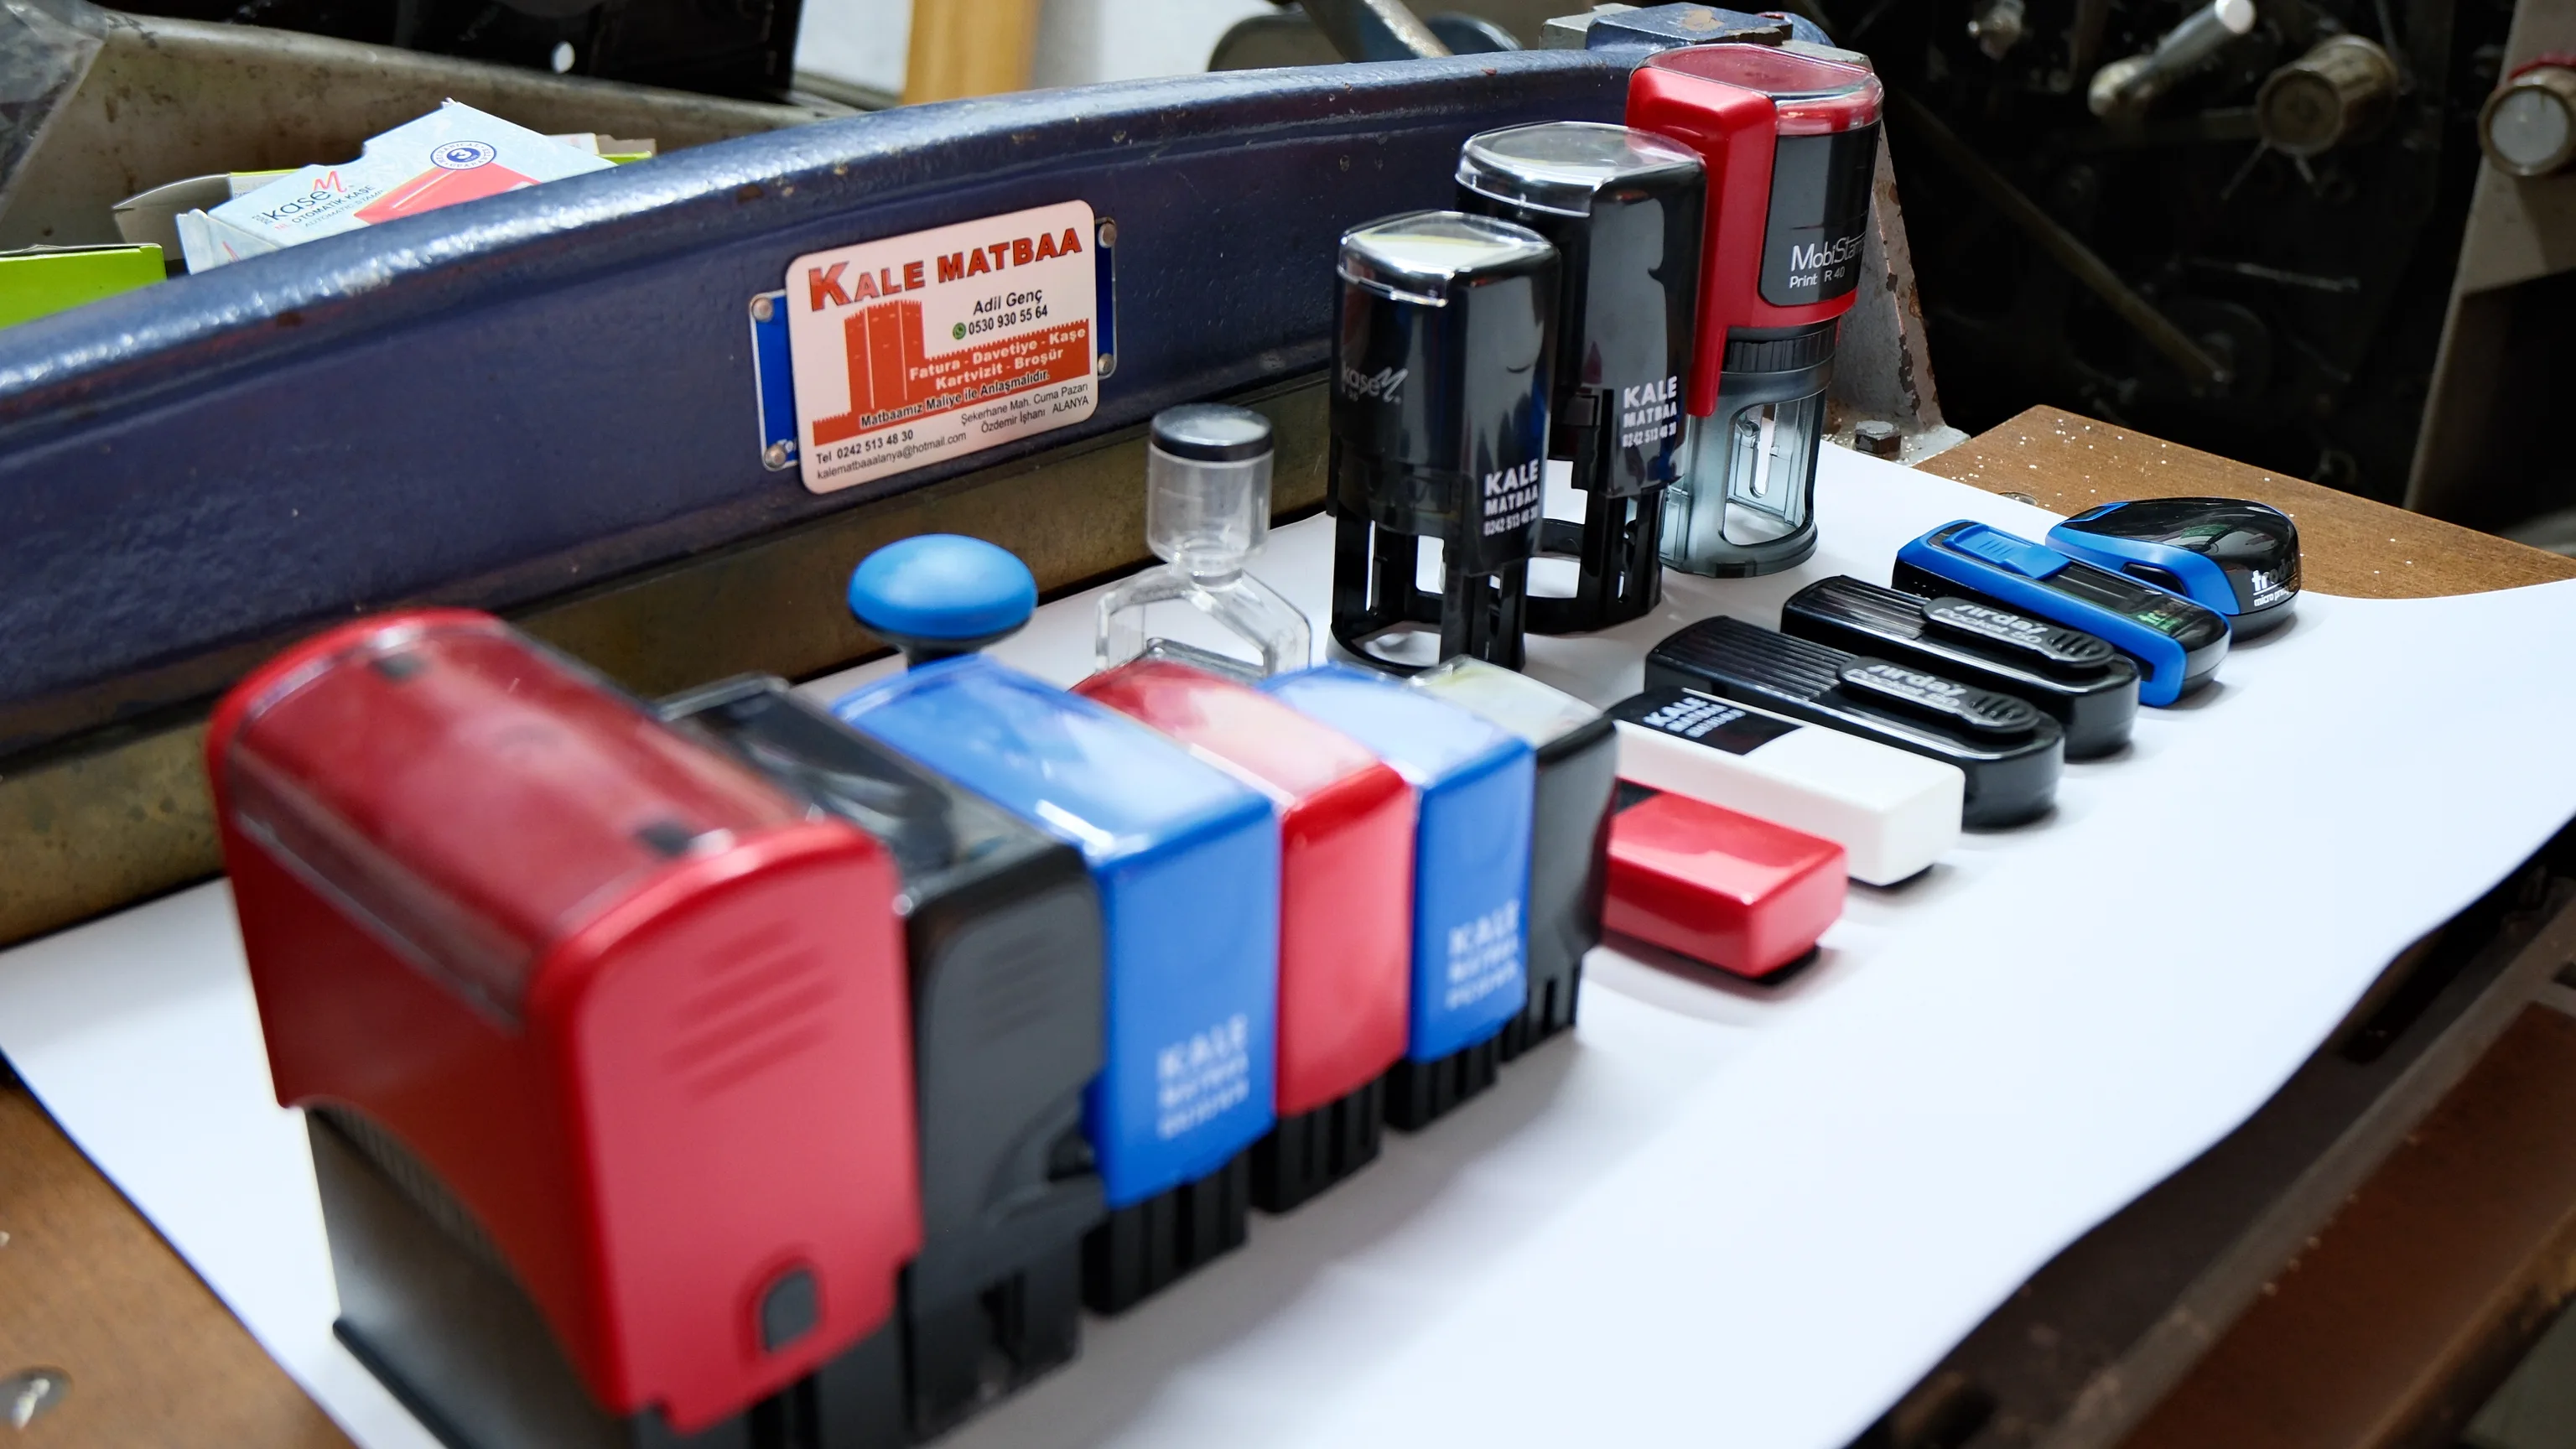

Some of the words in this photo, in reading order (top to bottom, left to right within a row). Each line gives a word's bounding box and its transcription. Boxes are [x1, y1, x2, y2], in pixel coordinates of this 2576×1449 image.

[450, 148, 472, 160] 3
[808, 261, 927, 313] KALE
[937, 227, 1083, 283] MATBAA
[1789, 273, 1818, 288] Print
[1824, 271, 1832, 282] R
[1833, 266, 1845, 279] 40
[969, 318, 995, 335] 0530
[997, 312, 1016, 329] 930
[1020, 307, 1032, 323] 55
[1035, 304, 1048, 319] 64
[973, 295, 1002, 316] Adil
[1005, 289, 1043, 308] Genç
[910, 359, 961, 381] Fatura
[973, 340, 1038, 366] Davetiye
[1049, 328, 1086, 345] Kaşe
[936, 362, 1003, 391] Kartvizit
[1014, 349, 1063, 370] Broşür
[860, 404, 923, 428] Matbaamız
[926, 392, 962, 411] Maliye
[964, 388, 978, 401] ile
[961, 402, 1008, 426] Şekerhane
[1010, 396, 1031, 411] Mah.
[1033, 390, 1059, 404] Cuma
[1061, 382, 1088, 397] Pazarı
[1623, 376, 1677, 408] KALE
[981, 414, 1017, 434] Özdemir
[1052, 397, 1089, 414] ALANYA
[816, 450, 833, 465] Tel
[837, 443, 861, 460] 0242
[865, 437, 883, 452] 513
[886, 433, 898, 446] 48
[901, 429, 913, 441] 30
[1484, 458, 1539, 497] KALE
[2254, 594, 2274, 606] micro
